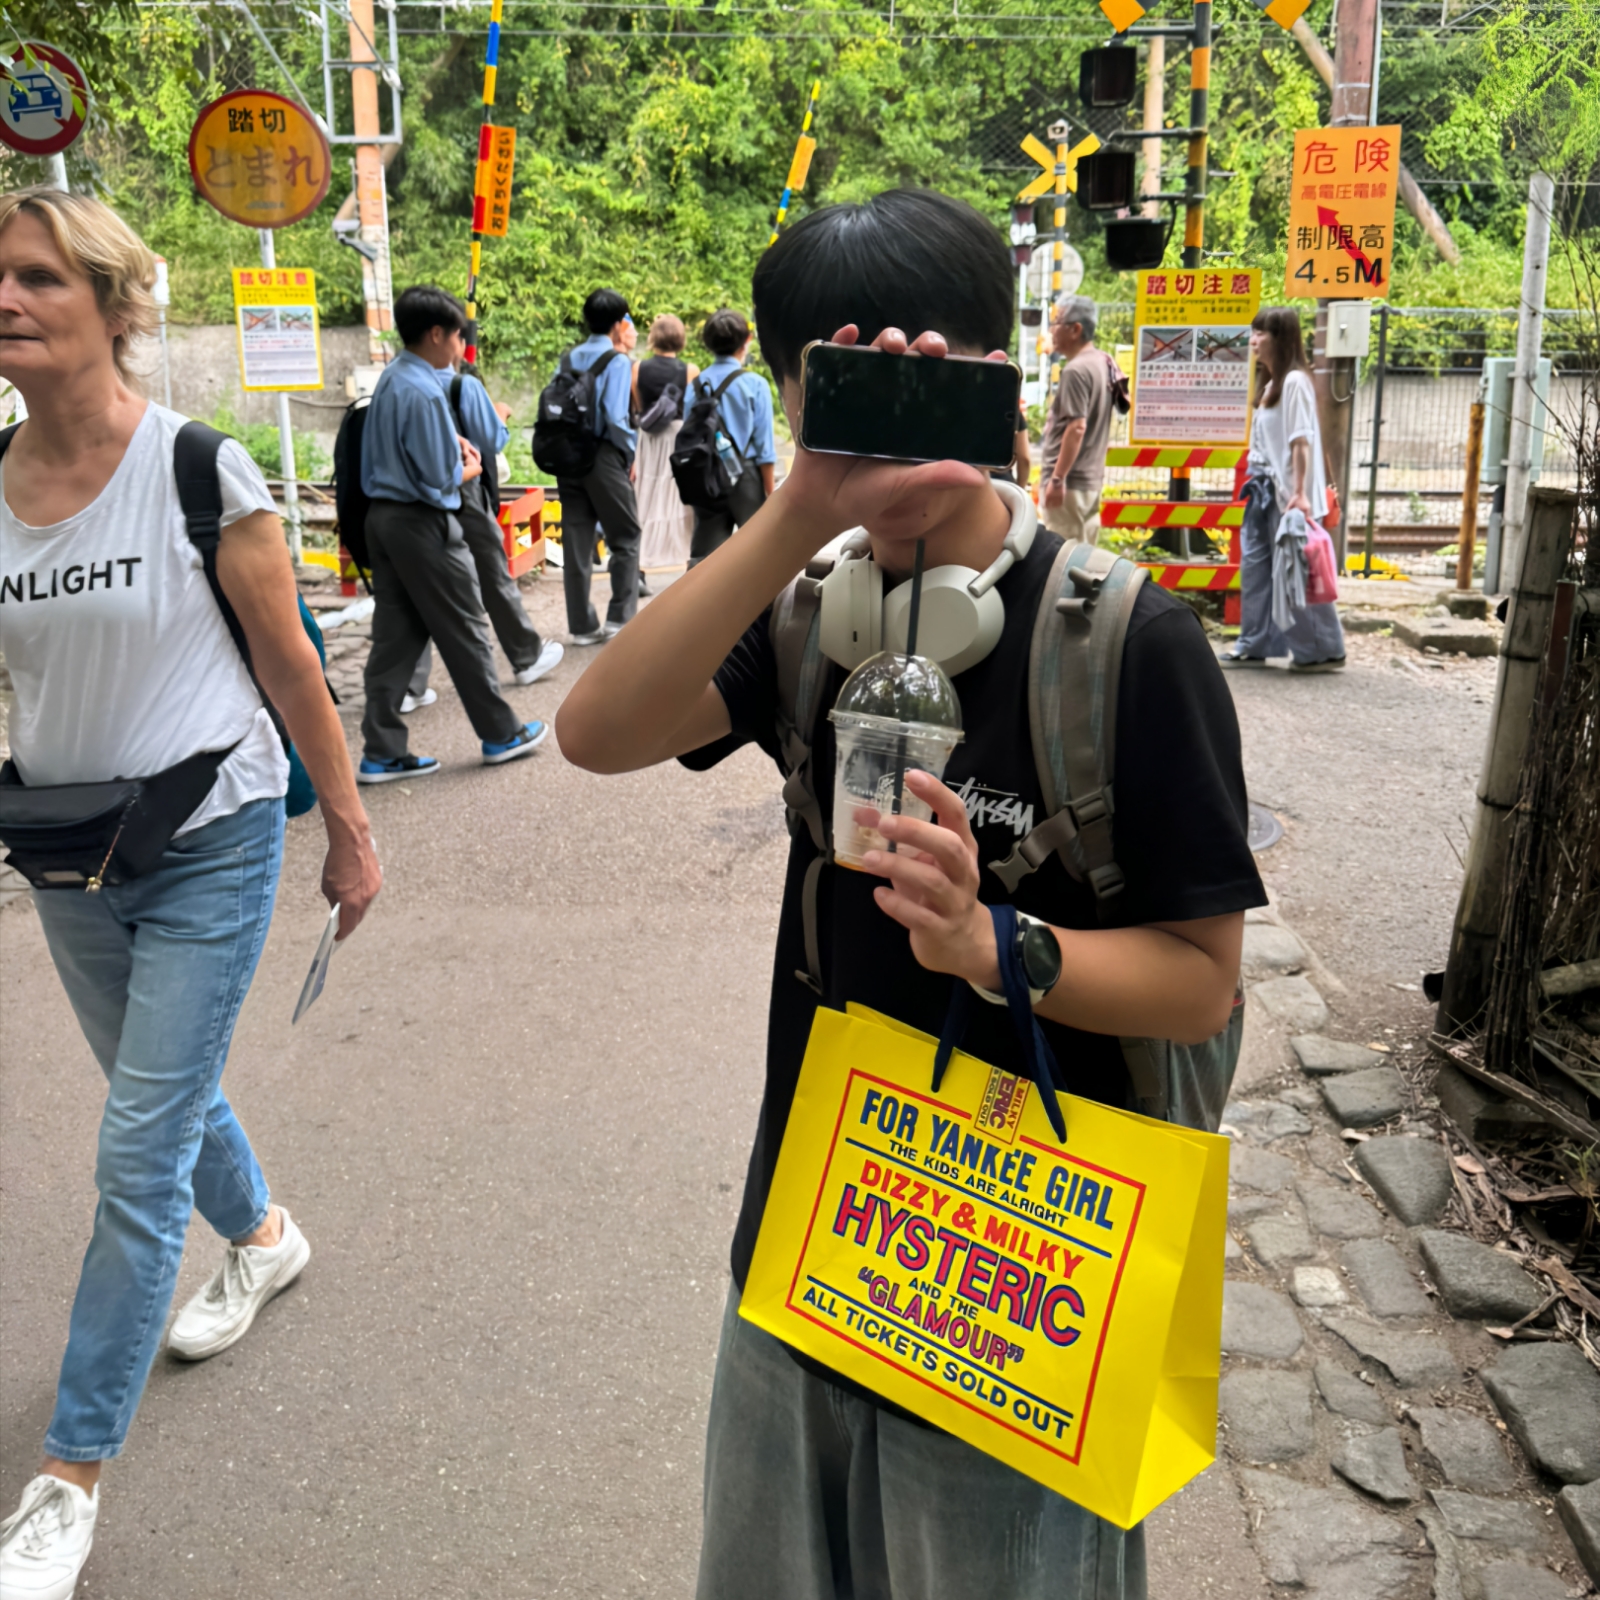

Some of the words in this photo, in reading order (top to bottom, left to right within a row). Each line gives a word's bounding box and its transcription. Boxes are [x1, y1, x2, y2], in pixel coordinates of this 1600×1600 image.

[228, 107, 286, 133] 踏切
[205, 144, 320, 188] とまれ
[1302, 137, 1391, 175] 危険
[491, 131, 511, 231] おまちください
[1301, 182, 1388, 201] 高電圧電線
[1297, 223, 1386, 251] 制限高
[1146, 273, 1251, 296] 踏切注意
[1294, 257, 1384, 285] 4.5M
[0, 556, 142, 604] NLIGHT
[859, 1088, 919, 1143] FOR
[1044, 1165, 1114, 1231] GIRL
[889, 1139, 918, 1161] THE
[923, 1155, 960, 1180] KIDS
[964, 1174, 997, 1197] ARE
[999, 1189, 1069, 1228] ALRIGHT
[860, 1158, 951, 1218] DIZZY
[951, 1201, 977, 1236] &
[983, 1214, 1085, 1280] MILKY
[832, 1182, 1086, 1347] HYSTERIC
[908, 1277, 942, 1300] AND
[949, 1295, 979, 1321] THE
[803, 1286, 838, 1319] ALL
[846, 1306, 939, 1382] TICKETS
[942, 1361, 1007, 1408] SOLD
[1012, 1398, 1071, 1439] OUT
